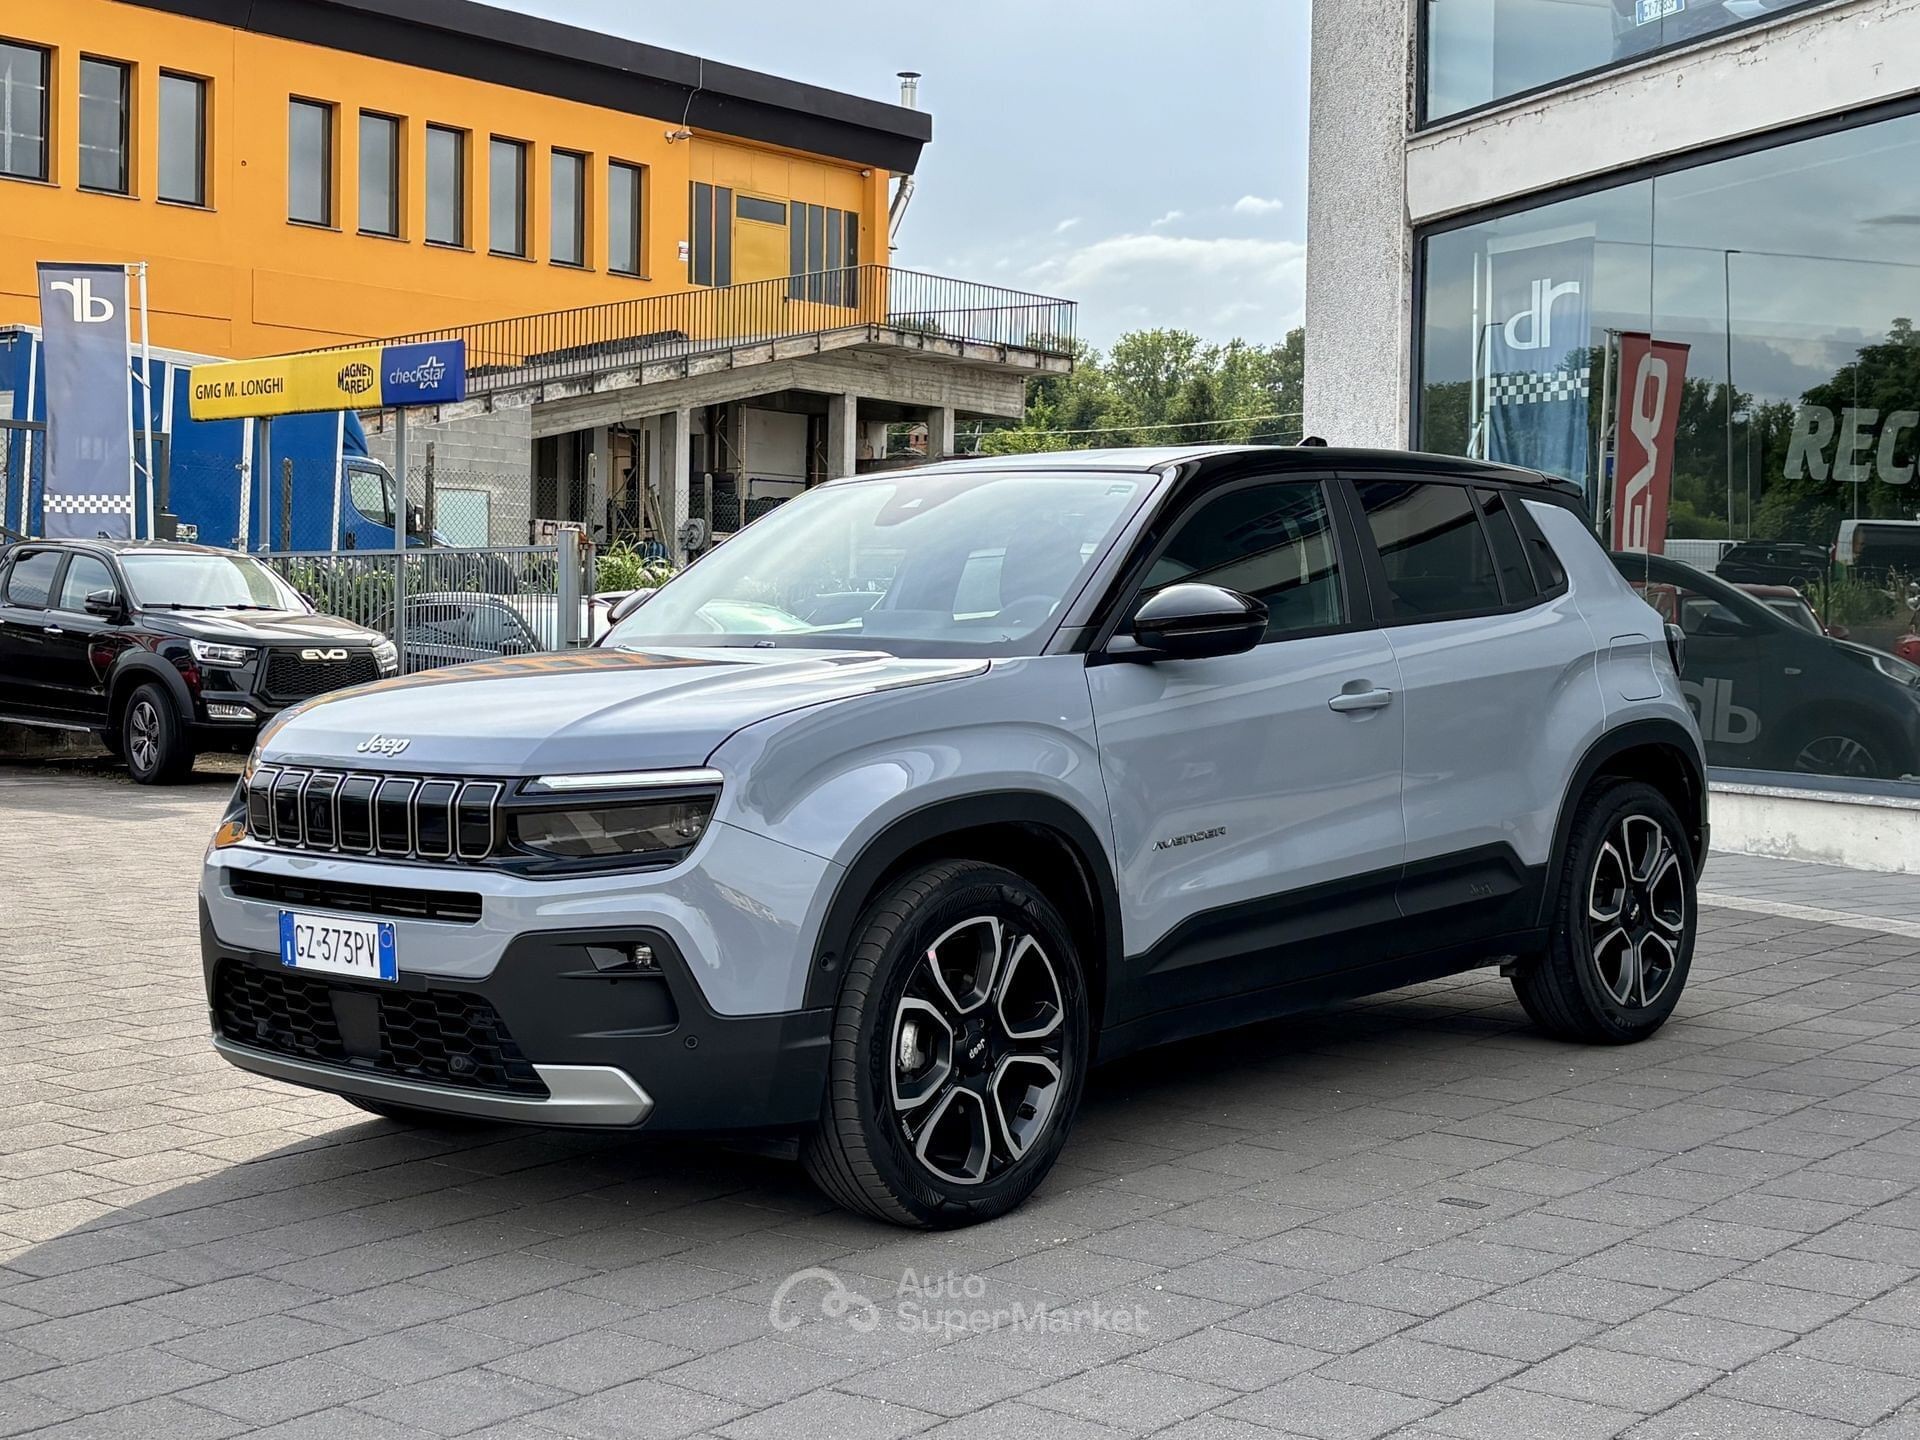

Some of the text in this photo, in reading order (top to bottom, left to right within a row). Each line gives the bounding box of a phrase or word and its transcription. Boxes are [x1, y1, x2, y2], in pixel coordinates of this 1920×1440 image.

[1504, 278, 1580, 350] dr
[389, 367, 446, 385] checkstar
[195, 377, 284, 400] GMG M. LONGHI
[1783, 403, 1920, 485] REC
[301, 648, 348, 660] EVO
[356, 733, 412, 758] Jeep
